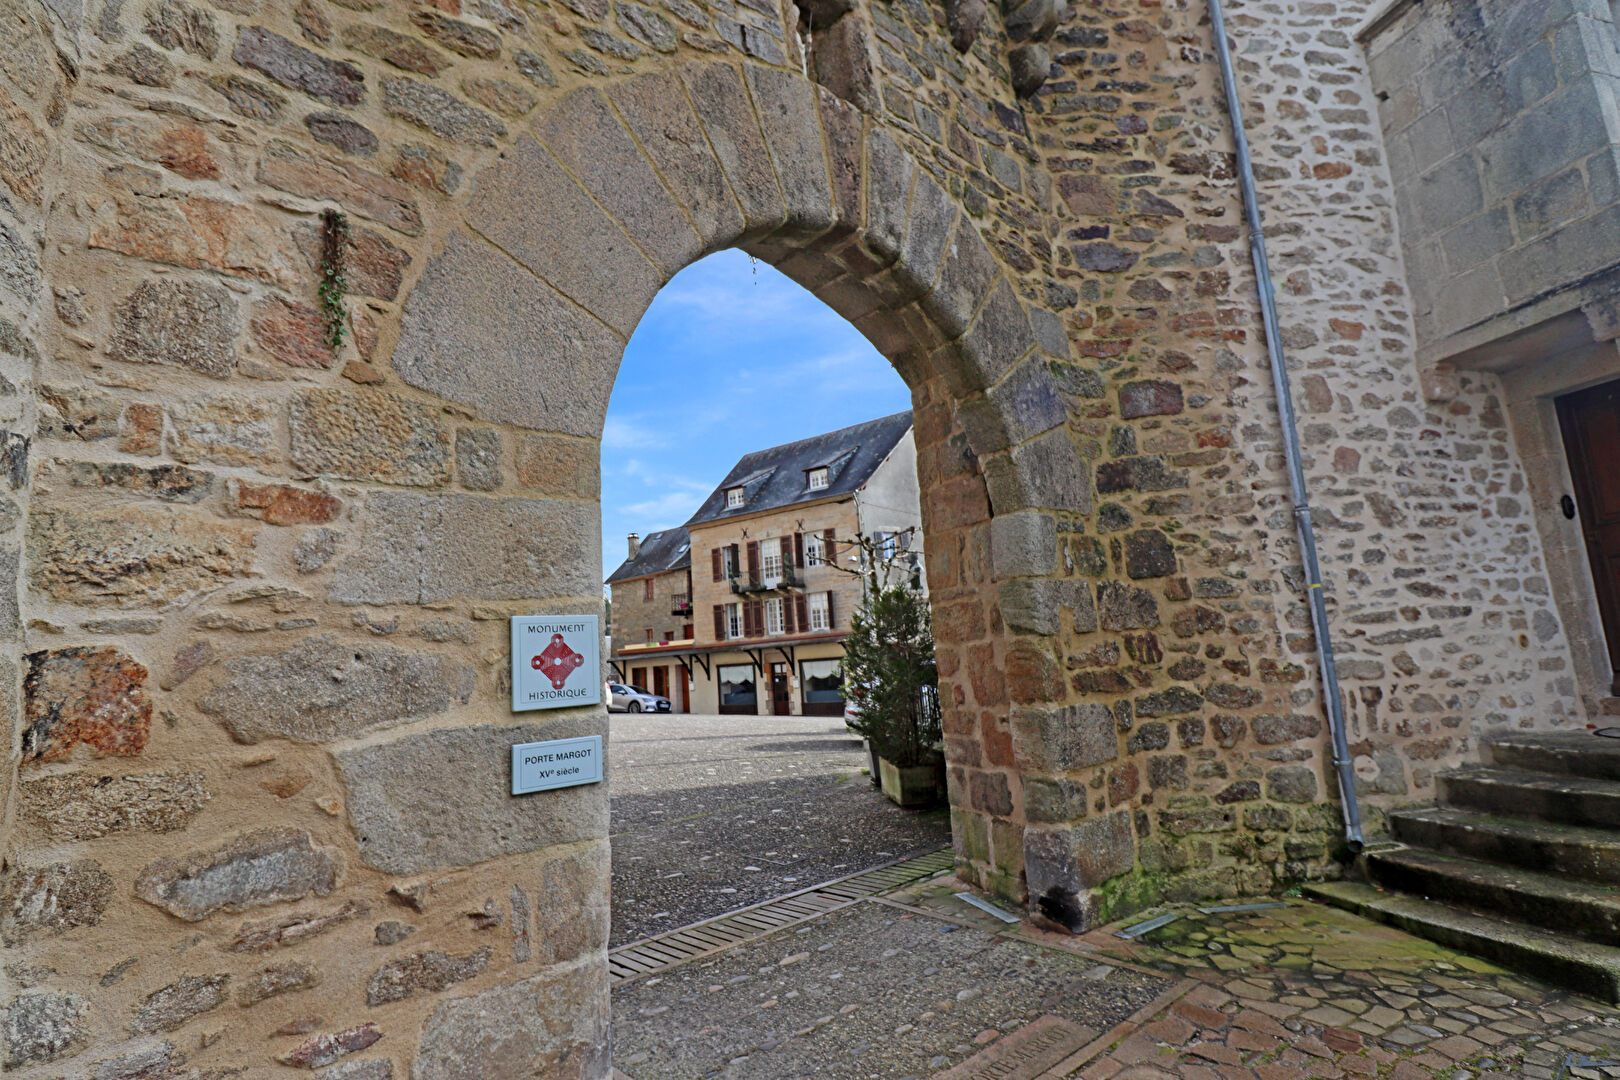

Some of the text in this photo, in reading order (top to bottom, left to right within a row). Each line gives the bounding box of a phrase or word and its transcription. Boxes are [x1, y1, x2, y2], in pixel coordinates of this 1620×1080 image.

[528, 624, 585, 634] MONUMENT
[529, 688, 587, 701] HISTORIQUE
[525, 749, 592, 765] PORTE MARGOT
[557, 766, 580, 776] siècle
